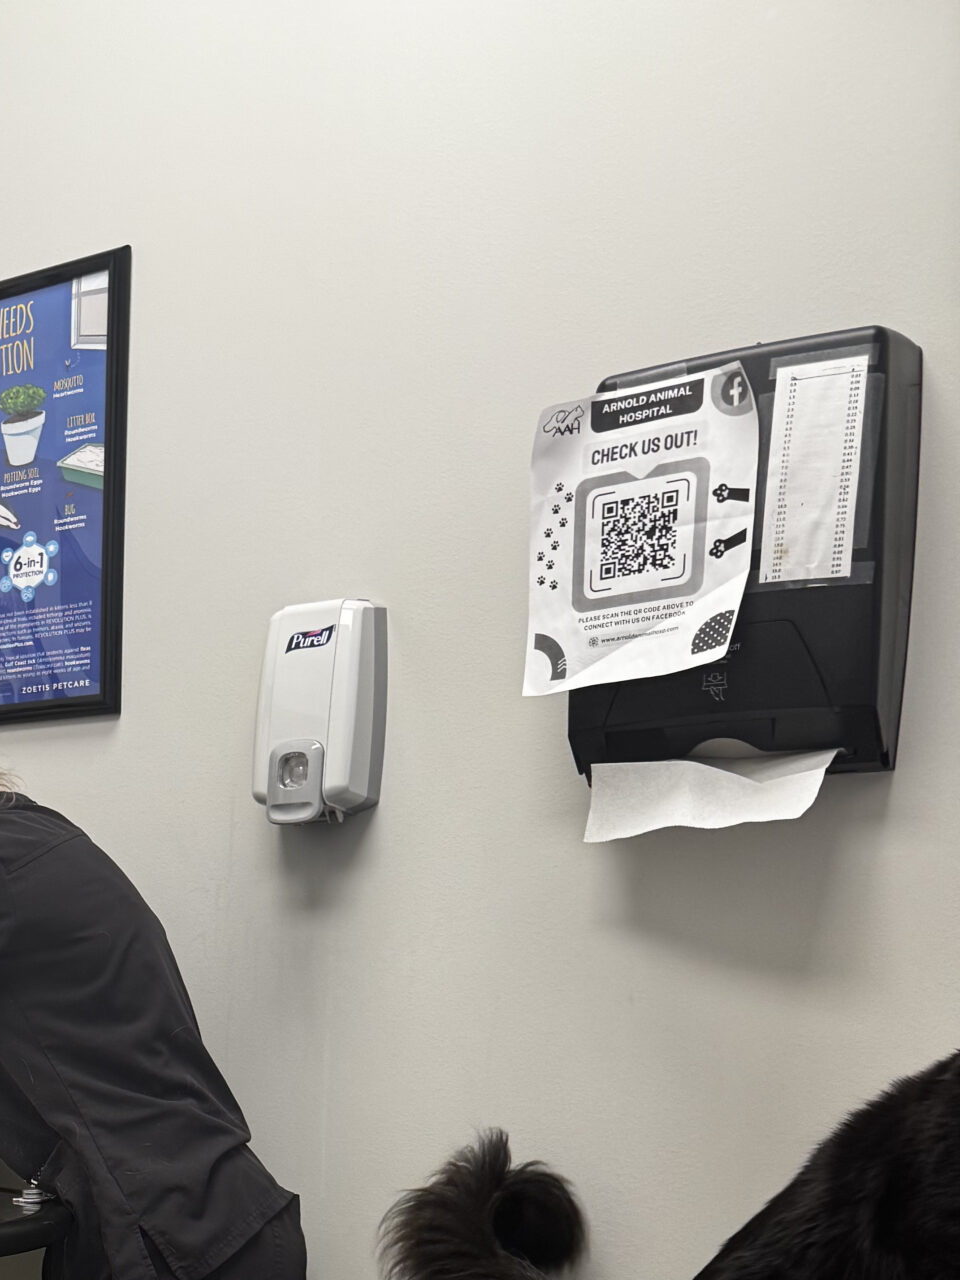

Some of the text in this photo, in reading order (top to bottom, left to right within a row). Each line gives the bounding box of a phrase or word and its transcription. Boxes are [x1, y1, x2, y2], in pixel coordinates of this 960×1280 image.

[54, 375, 83, 392] MOSQUITO
[602, 385, 692, 414] ARNOLD ANIMAL
[67, 414, 84, 428] LITTER
[619, 408, 673, 424] HOSPITAL
[552, 420, 580, 437] AAH
[591, 429, 698, 466] CHECK US OUT!
[4, 469, 26, 484] POTTING
[65, 504, 75, 515] BUG
[14, 552, 44, 572] 6-in-1
[13, 570, 43, 579] PROTECTION
[578, 614, 601, 624] PLEASE
[602, 612, 619, 620] SCAN
[620, 610, 632, 618] THE
[633, 608, 643, 616] QR
[644, 605, 661, 614] CODE
[662, 602, 684, 611] ABOVE
[584, 621, 613, 631] CONNECT
[614, 618, 631, 626] WITH
[291, 630, 329, 648] Purell
[22, 680, 90, 694] ZOETIS PETCARE
